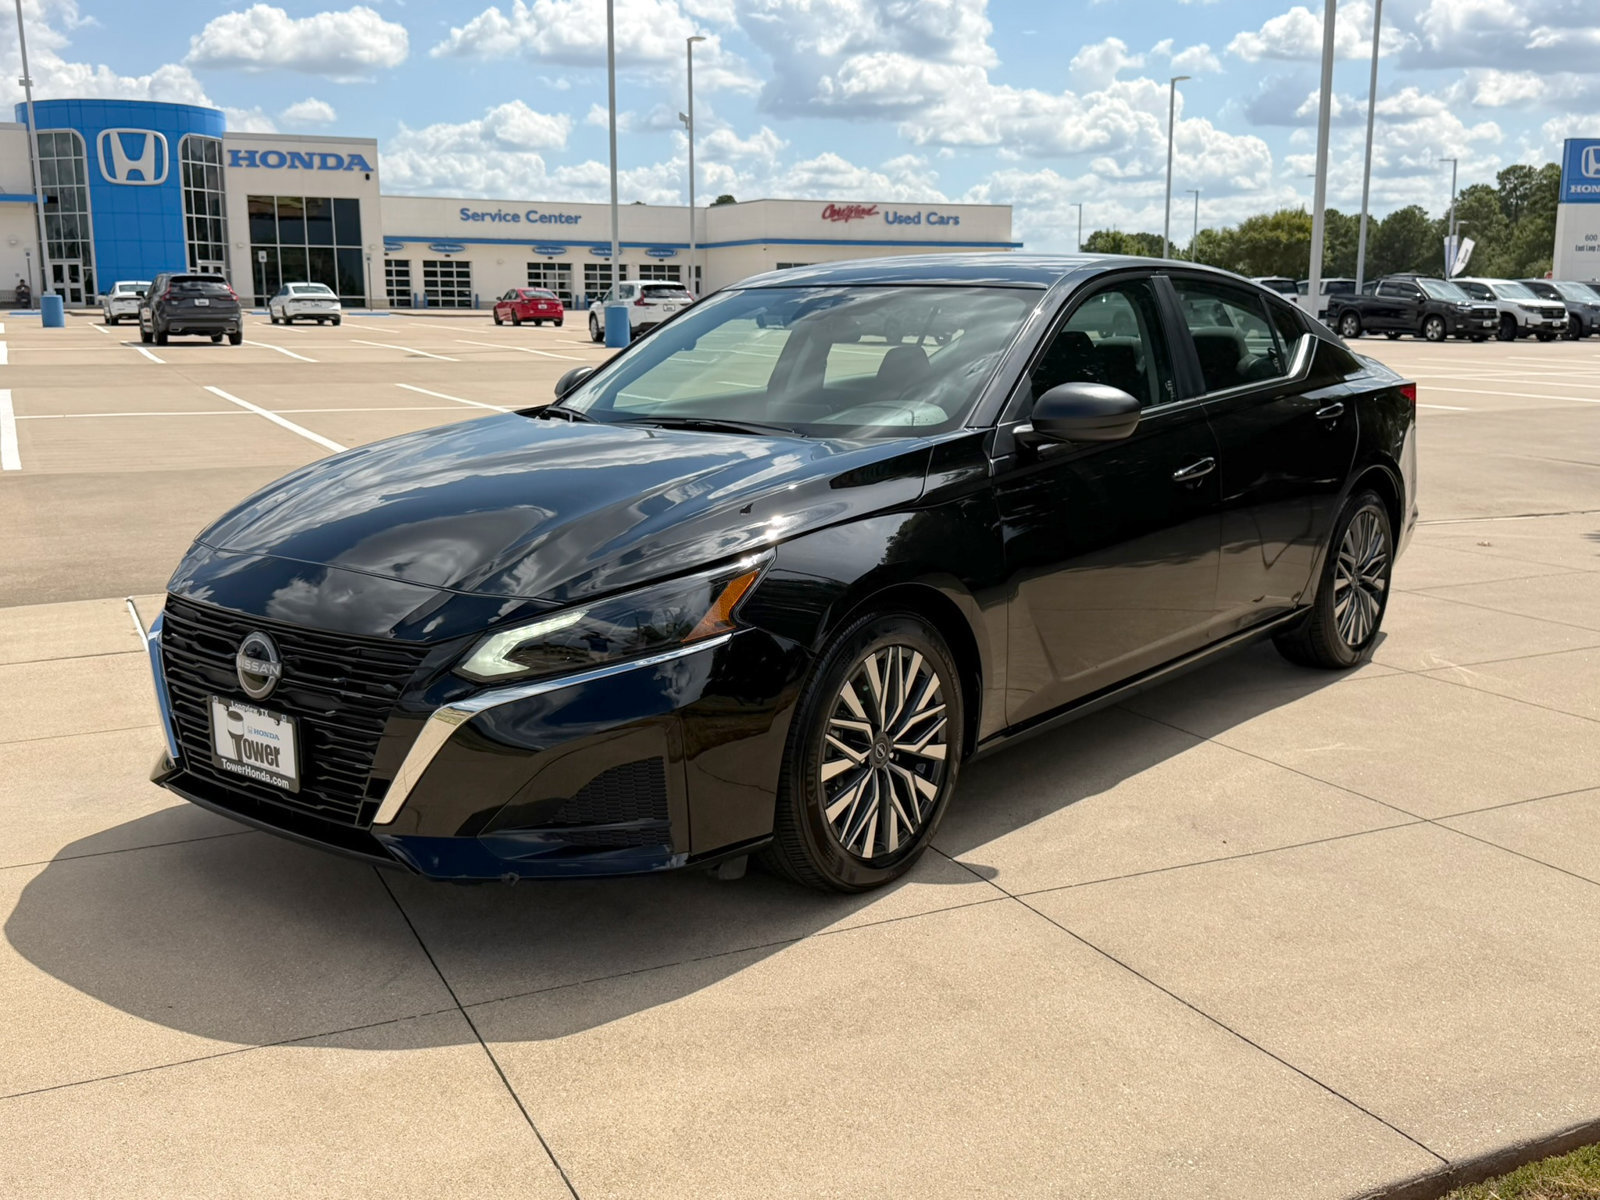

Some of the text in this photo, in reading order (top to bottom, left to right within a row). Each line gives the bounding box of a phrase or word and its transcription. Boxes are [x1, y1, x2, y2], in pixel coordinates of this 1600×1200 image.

[227, 149, 374, 172] HONDA
[1570, 184, 1600, 193] HON
[459, 207, 582, 224] Service Center
[884, 211, 921, 225] Used
[926, 211, 960, 225] Cars
[254, 728, 280, 740] HONDA
[221, 758, 290, 789] TowerHonda.com
